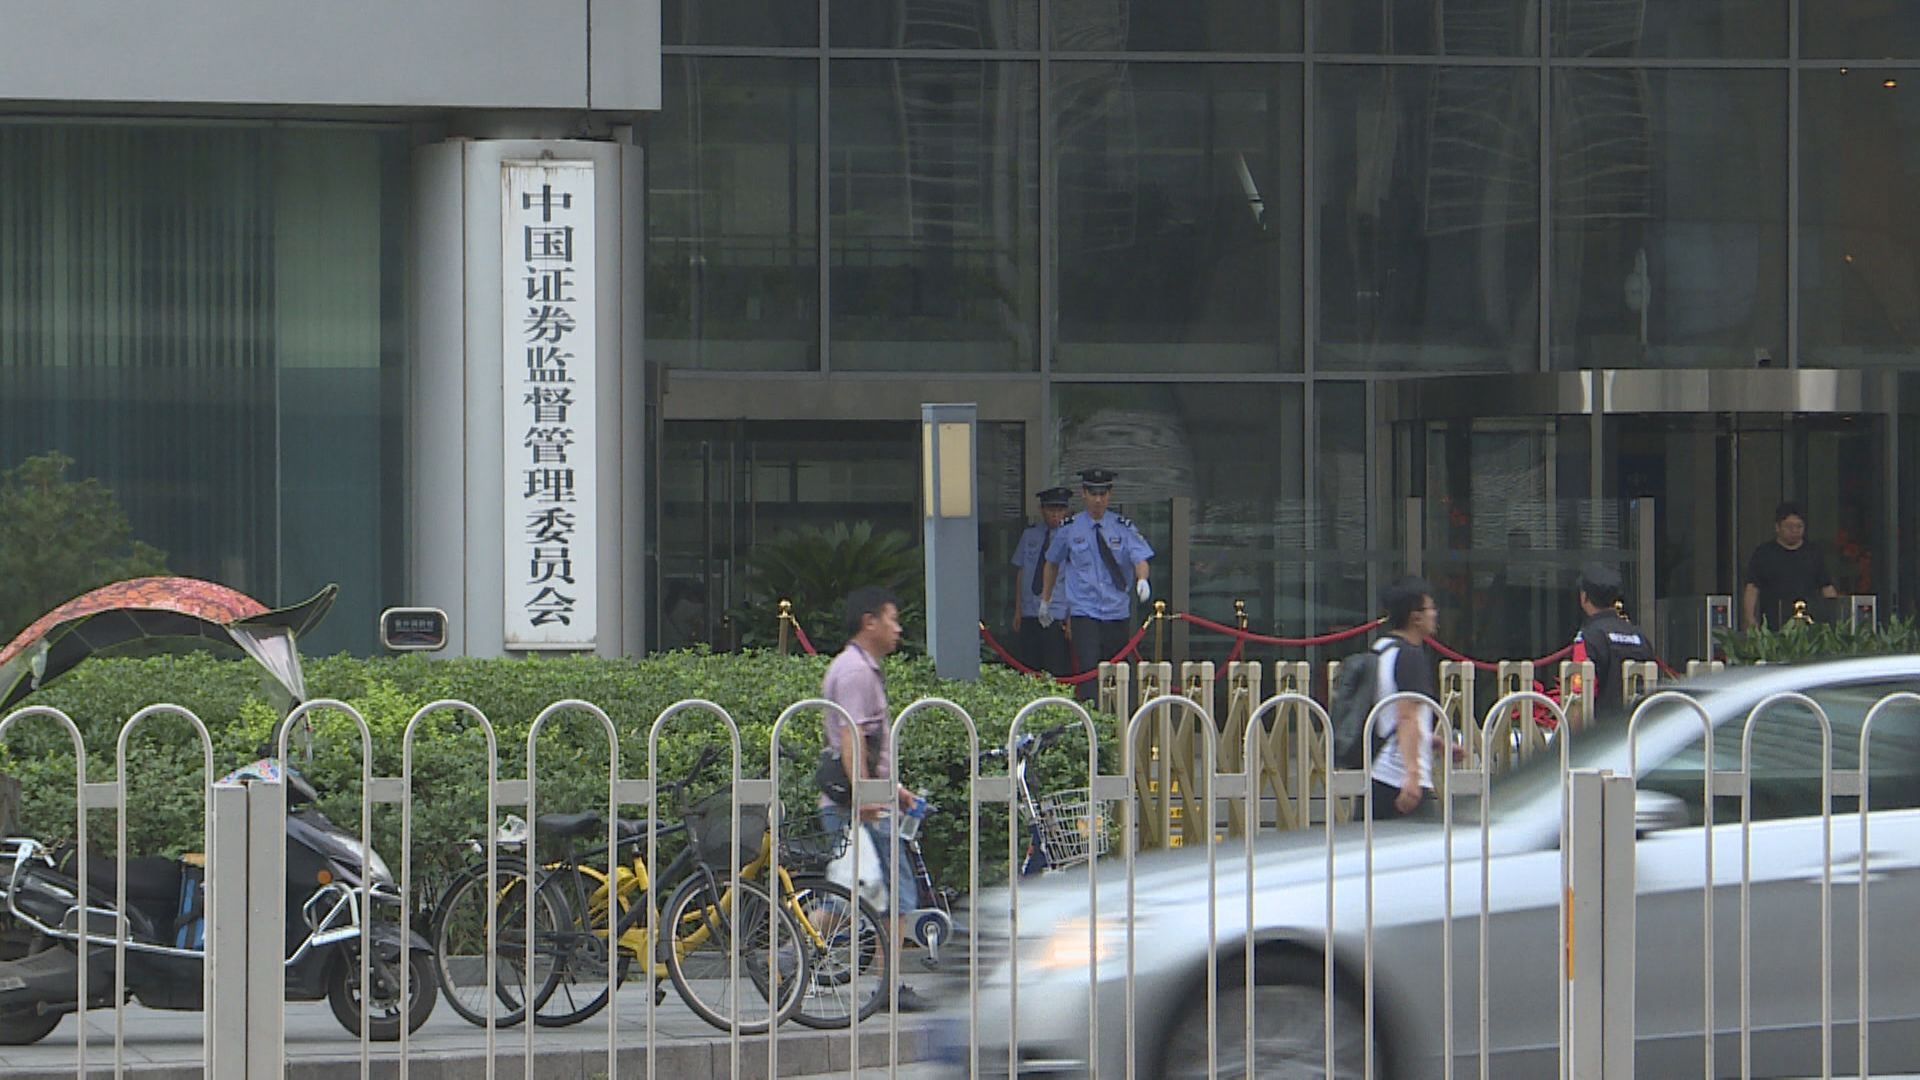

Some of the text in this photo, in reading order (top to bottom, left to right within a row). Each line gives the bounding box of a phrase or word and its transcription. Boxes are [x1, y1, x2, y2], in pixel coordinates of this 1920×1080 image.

[522, 184, 576, 626] 中国证券监督管理委员会
